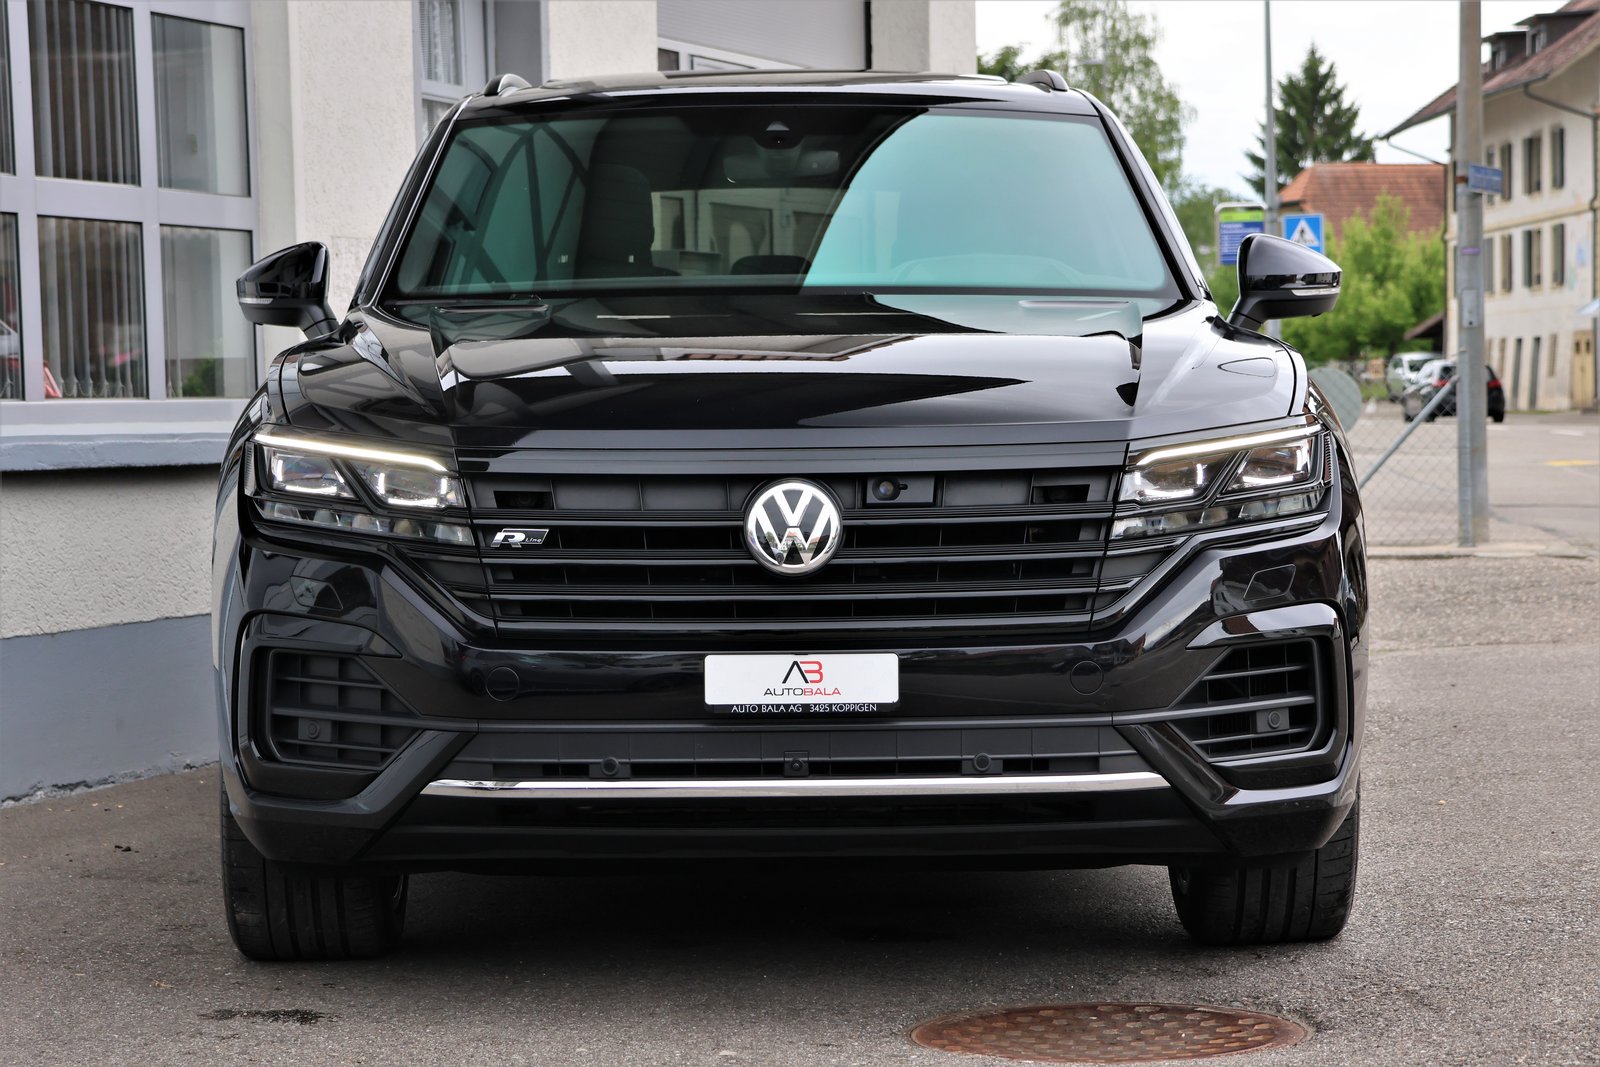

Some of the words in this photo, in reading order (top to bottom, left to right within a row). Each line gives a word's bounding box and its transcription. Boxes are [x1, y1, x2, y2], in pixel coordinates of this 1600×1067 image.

[748, 483, 838, 568] VW
[782, 660, 824, 684] AB
[763, 687, 842, 697] AUTOBALA
[731, 704, 759, 713] AUTO
[761, 704, 786, 713] BALA
[788, 703, 803, 713] AG
[809, 703, 830, 712] 3425
[832, 703, 877, 712] KOPPIGEN
